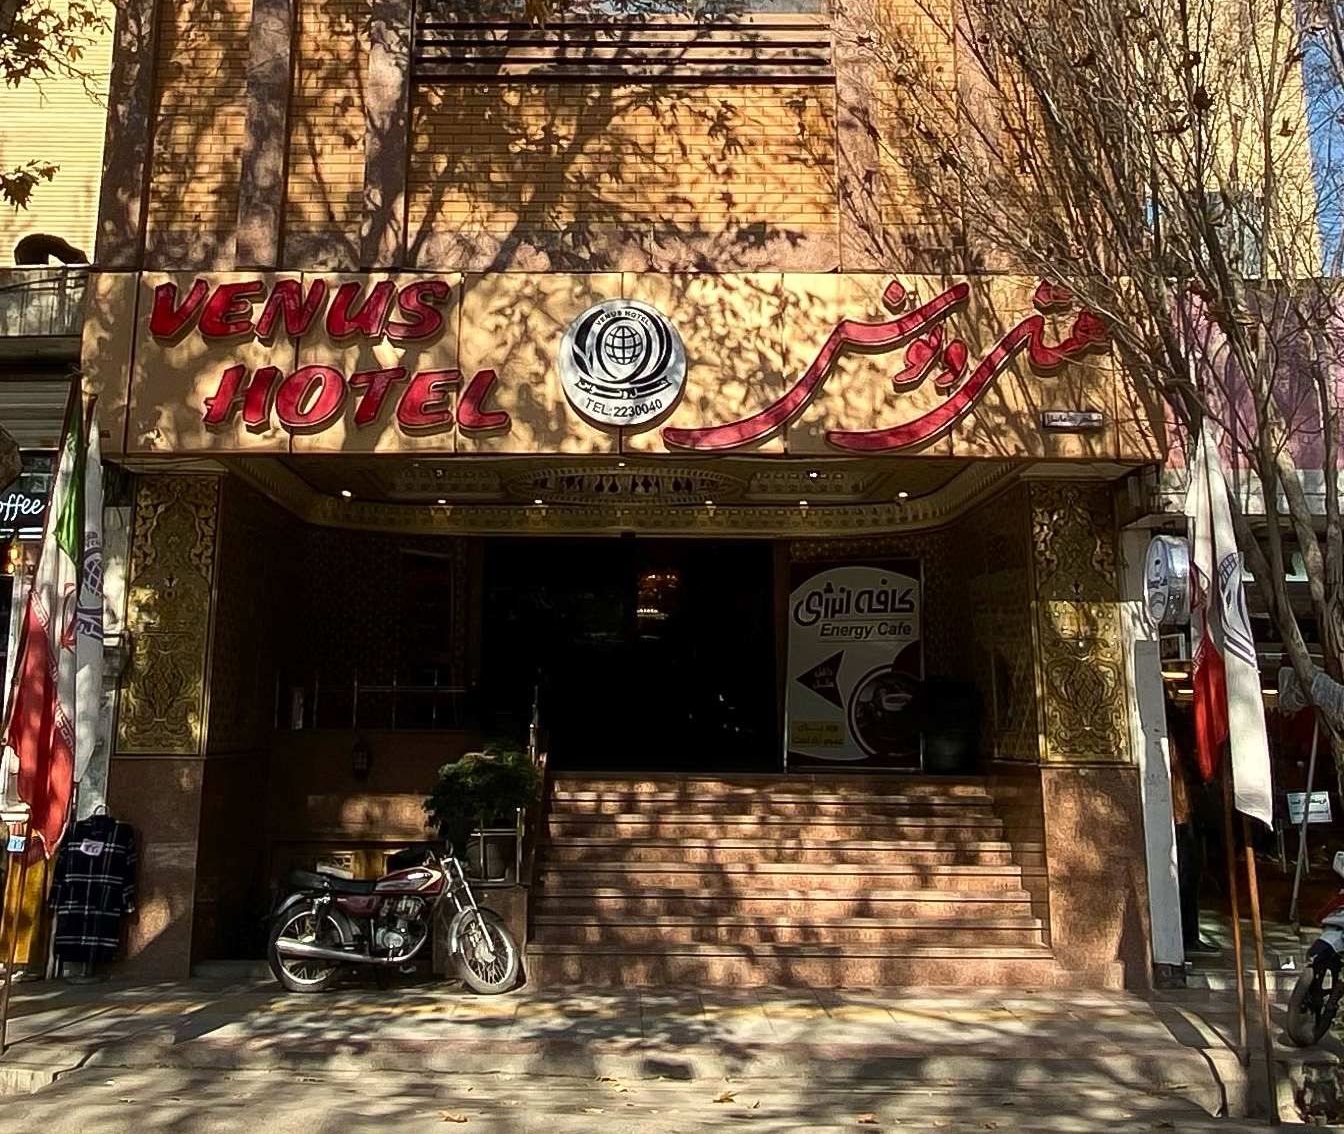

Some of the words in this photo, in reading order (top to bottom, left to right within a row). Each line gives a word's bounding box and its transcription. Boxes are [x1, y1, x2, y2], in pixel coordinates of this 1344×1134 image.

[149, 278, 452, 345] VENUS
[596, 310, 623, 326] VENUS
[624, 311, 651, 326] HOTEL
[202, 364, 512, 436] HOTEL
[793, 581, 852, 627] انرژی
[854, 577, 916, 614] کافه
[820, 623, 873, 639] Energy
[877, 622, 912, 636] Cafe
